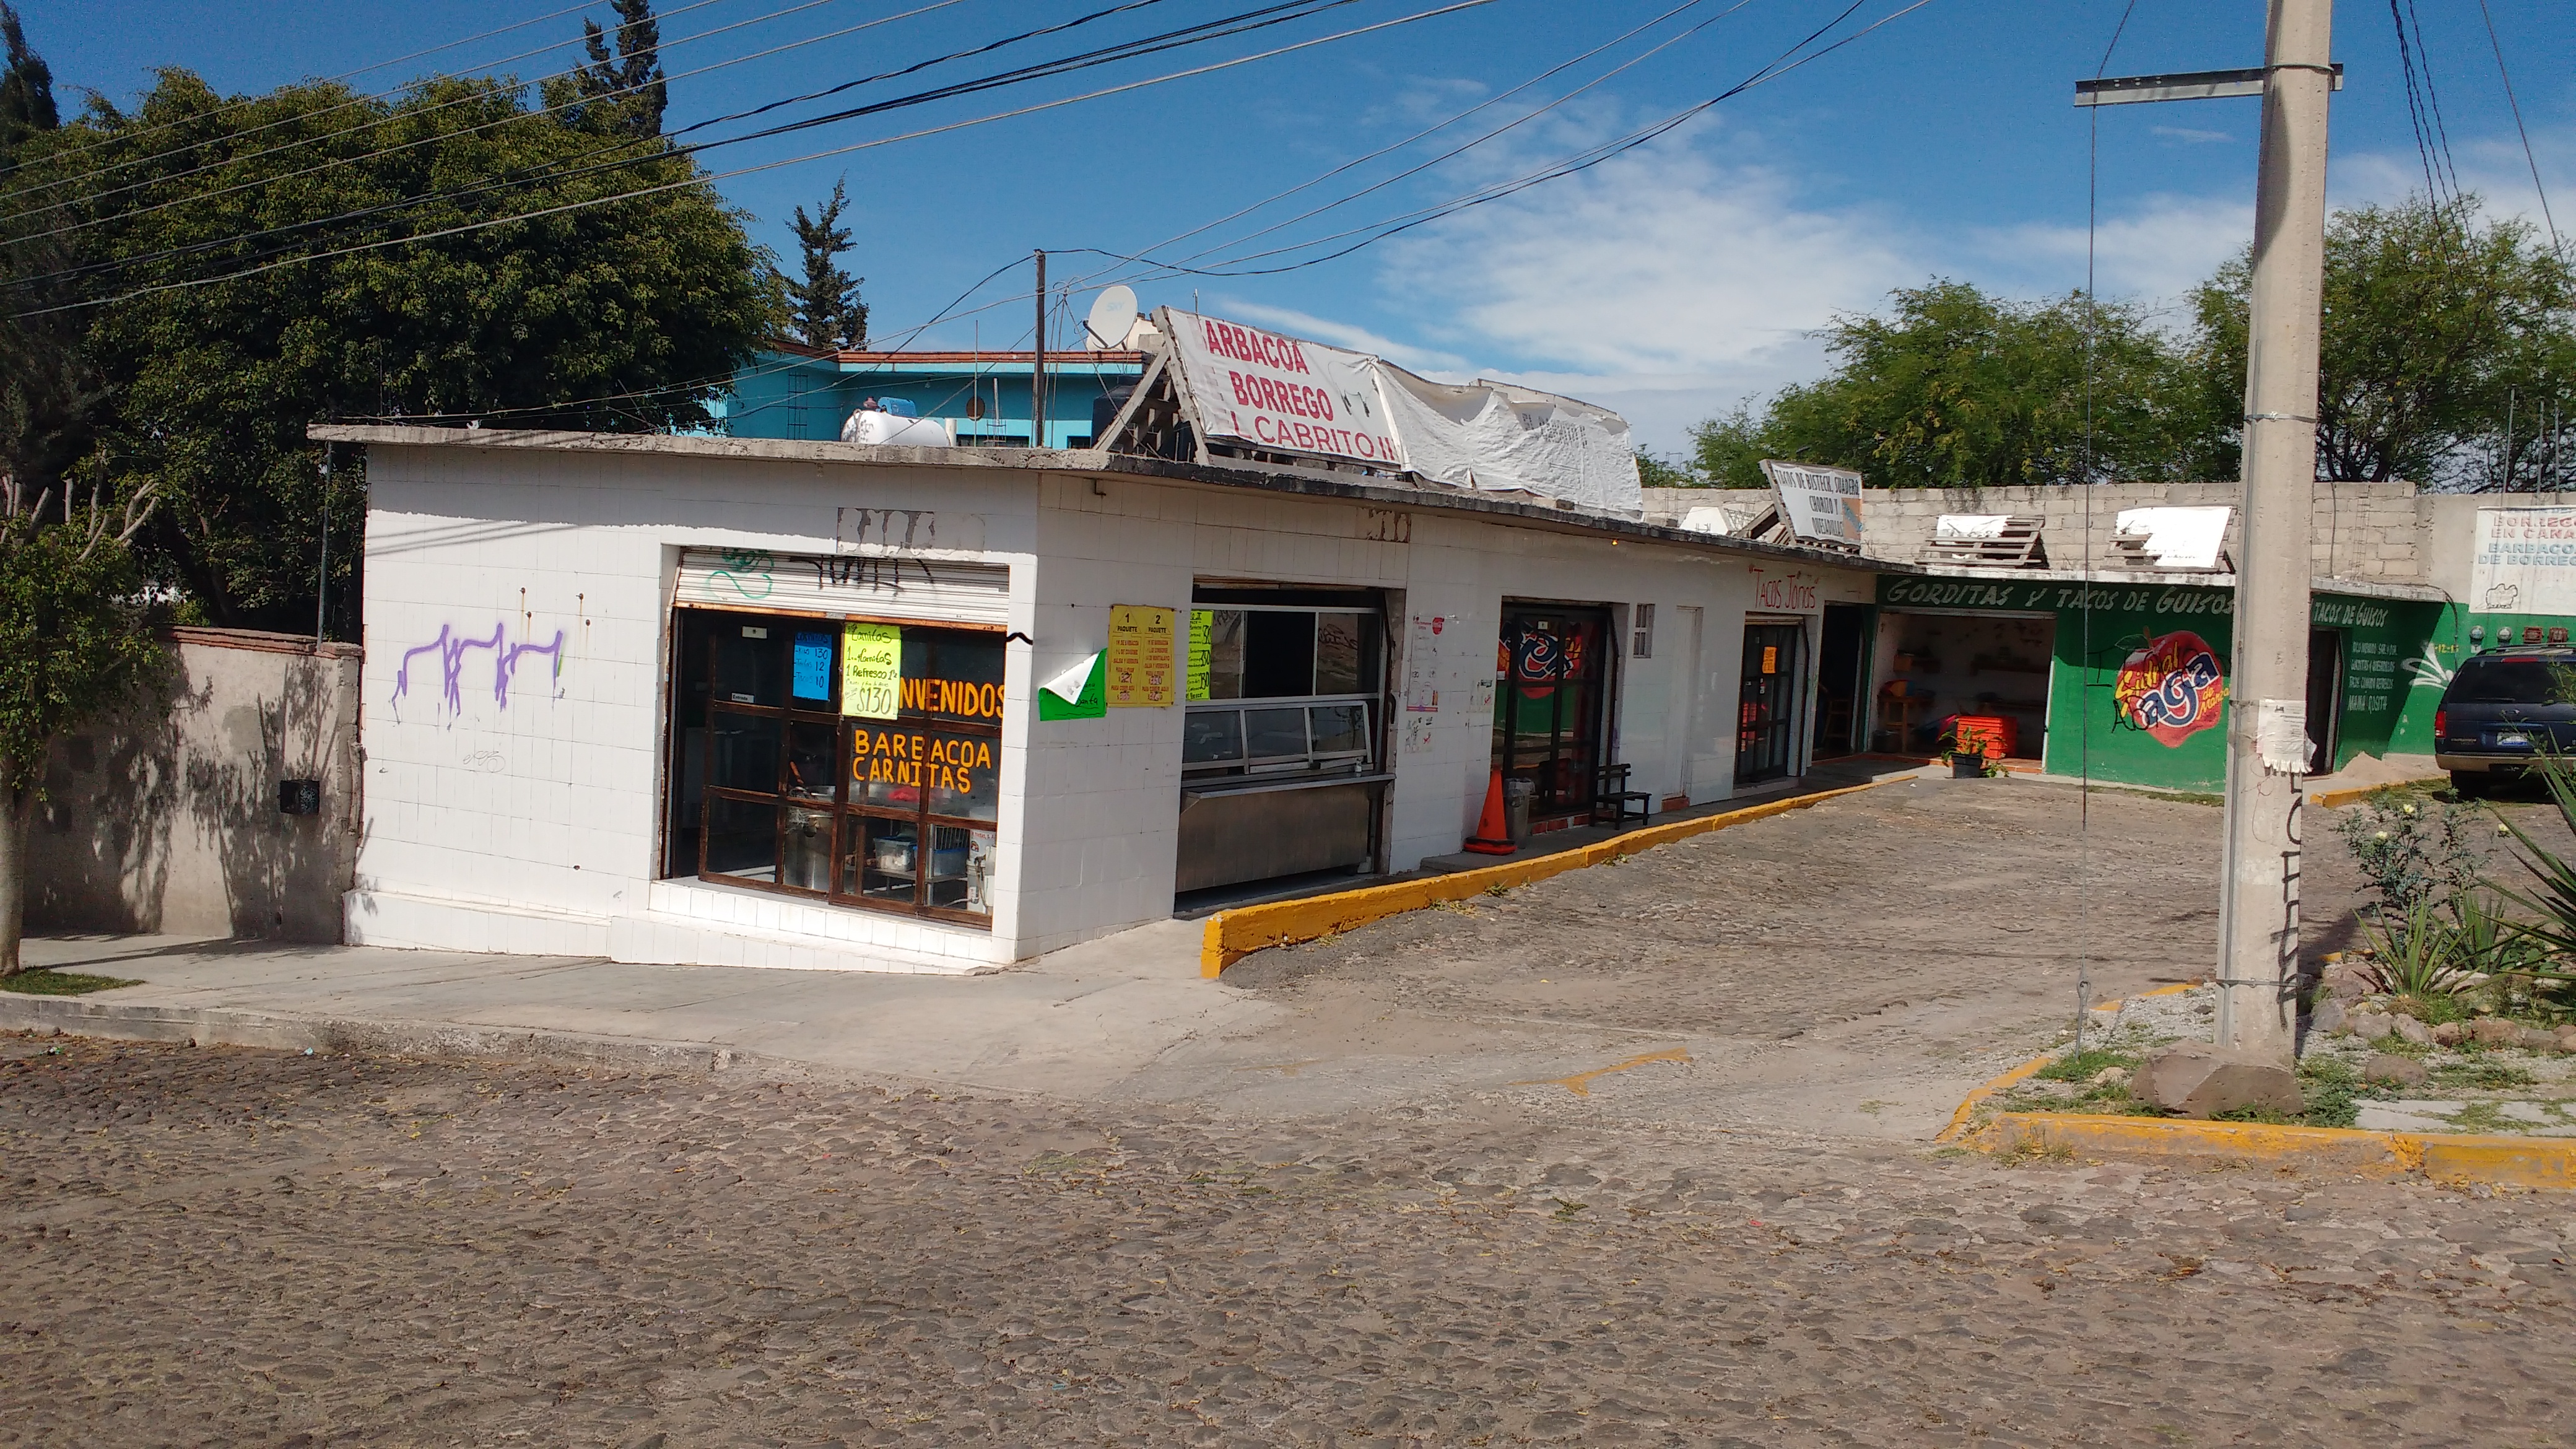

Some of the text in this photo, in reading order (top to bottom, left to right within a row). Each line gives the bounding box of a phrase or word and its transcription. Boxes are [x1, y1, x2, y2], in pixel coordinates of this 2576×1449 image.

[1229, 370, 1334, 422] BORREGO
[1255, 416, 1374, 458] CABRITO
[1775, 469, 1796, 488] TACOS
[1795, 472, 1806, 489] DE
[1809, 495, 1838, 515] CHORIZO Y
[2494, 516, 2576, 527] BORREG
[2491, 528, 2515, 538] EN
[2488, 543, 2576, 554] BARBACO
[2478, 554, 2500, 564] DE
[1887, 578, 2014, 606] GORDITAS
[2056, 589, 2119, 611] TACOS
[2123, 591, 2150, 612] DE
[2156, 586, 2234, 615] GUISOS
[1125, 613, 1129, 623] 1
[1155, 615, 1161, 624] 2
[2313, 601, 2388, 627] TACOS DE GUISOS
[815, 648, 828, 659] 130
[816, 661, 824, 671] 12
[816, 676, 824, 688] 10
[2202, 687, 2214, 700] de
[853, 756, 971, 793] CARNITAS
